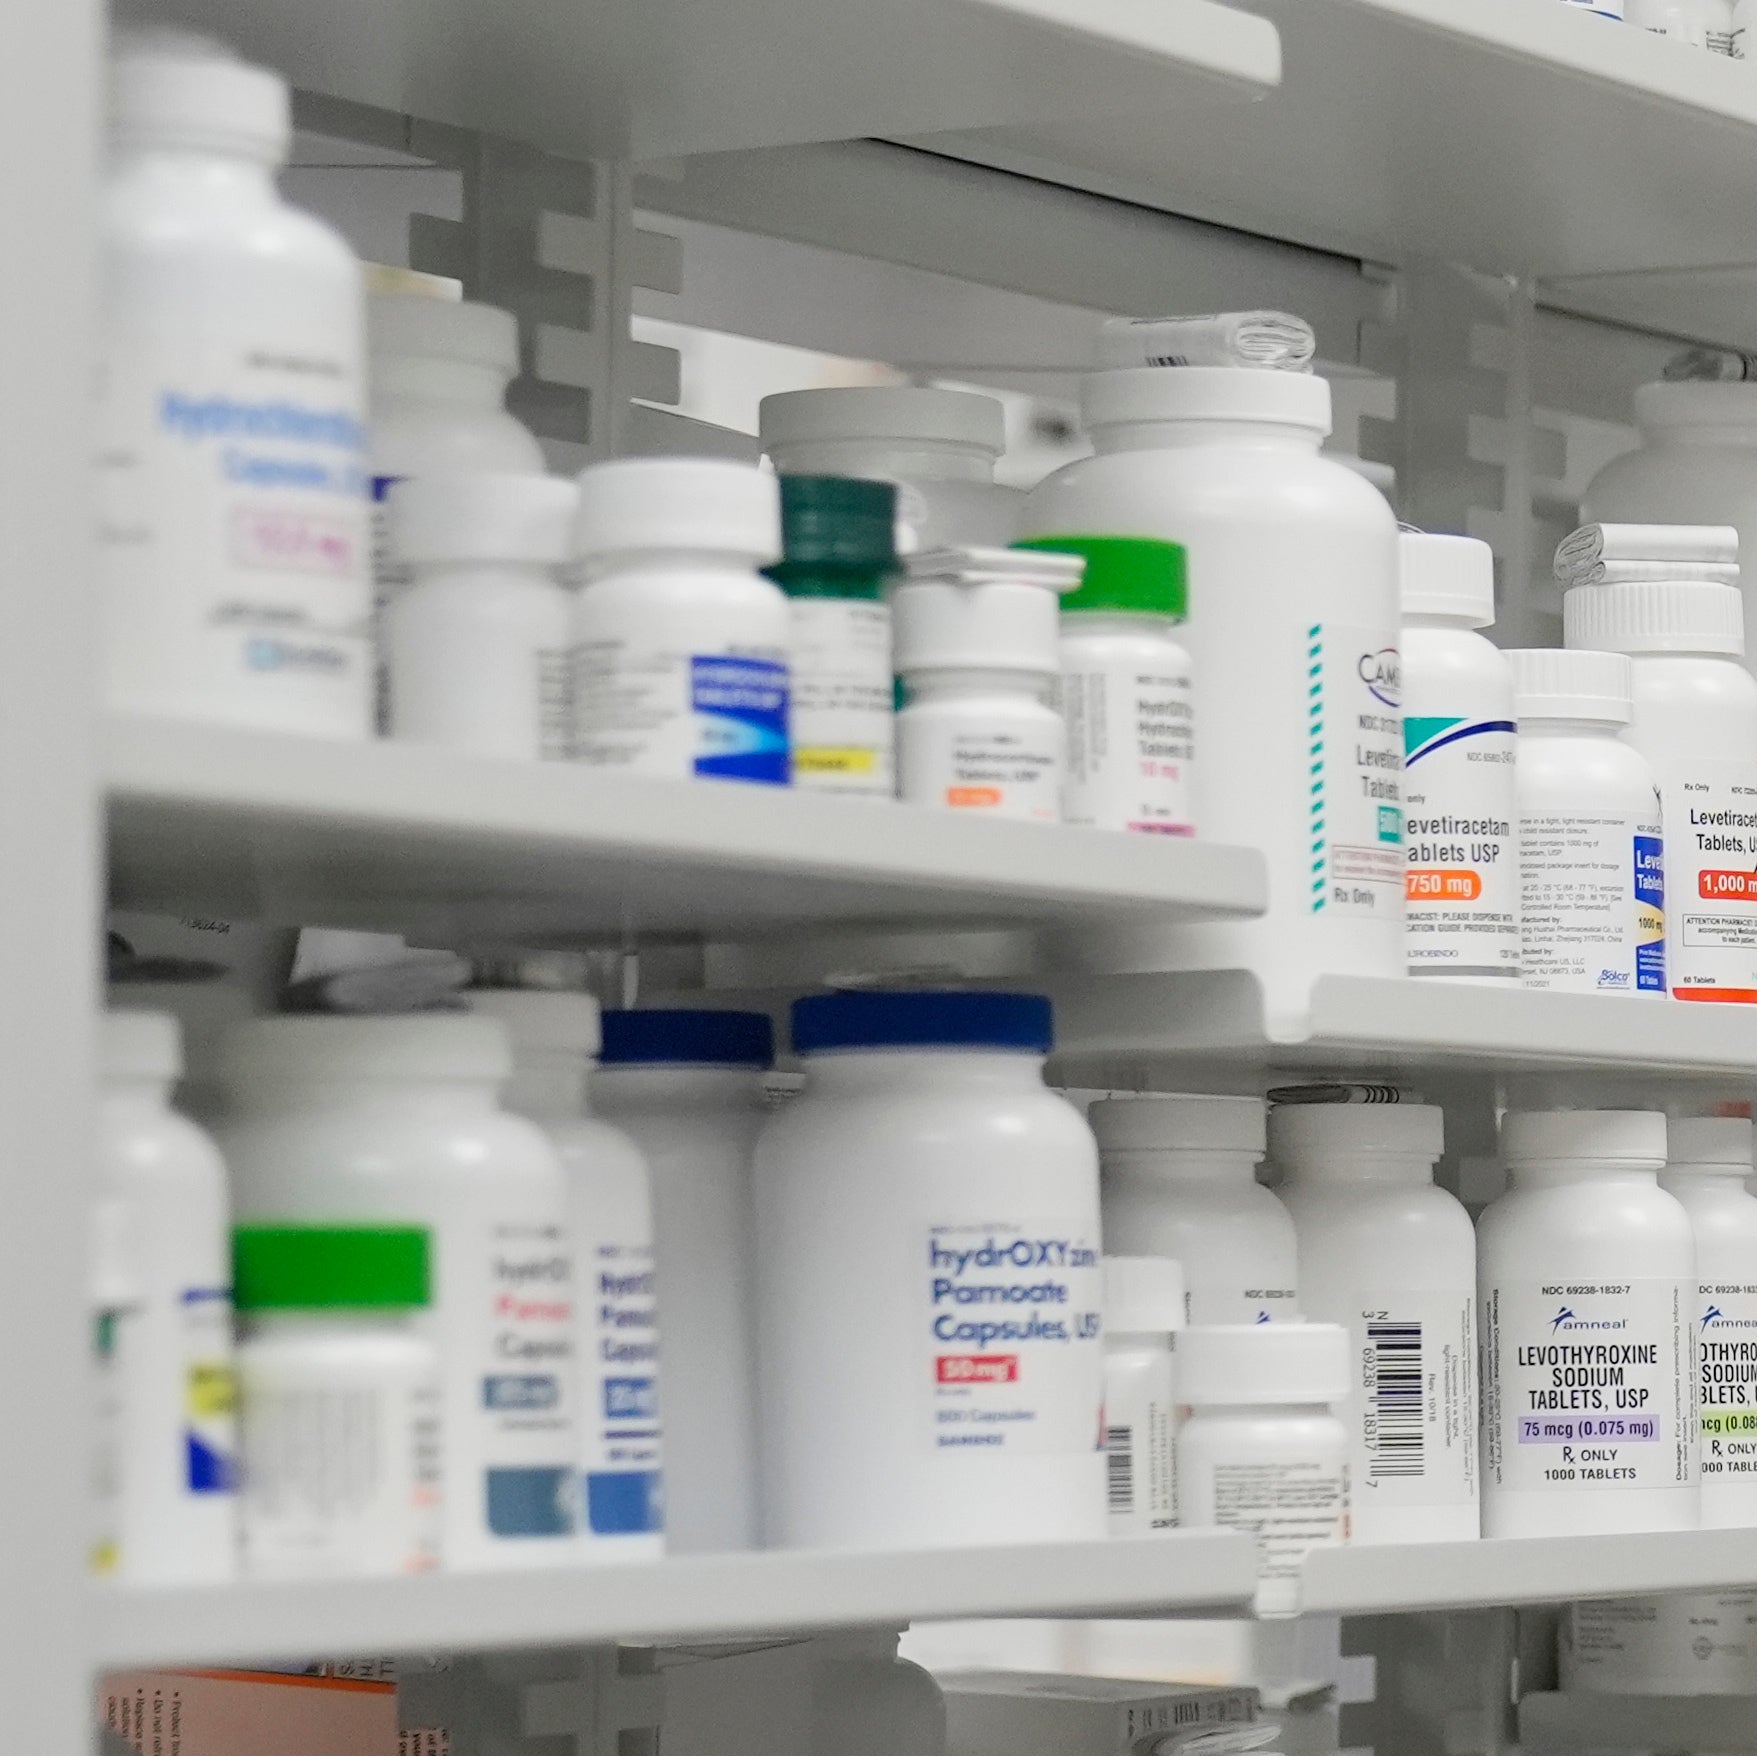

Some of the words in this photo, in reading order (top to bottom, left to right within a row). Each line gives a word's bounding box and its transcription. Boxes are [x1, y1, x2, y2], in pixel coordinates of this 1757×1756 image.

[1684, 783, 1695, 791] Rx
[1697, 783, 1710, 793] Only
[1408, 817, 1510, 837] evetiracetam
[1408, 844, 1465, 862] ablets
[1471, 844, 1500, 862] USP
[1696, 834, 1746, 855] Tablets,
[1408, 875, 1442, 893] 750
[1447, 876, 1472, 896] mg
[1703, 875, 1745, 893] 1,000
[1638, 917, 1654, 929] 1000
[1694, 976, 1716, 984] Tablets
[931, 1238, 1099, 1277] hydrOXYzin
[933, 1278, 1068, 1305] Pamoate
[1542, 1287, 1564, 1295] NDC
[1566, 1286, 1630, 1295] 69238-1832-7
[1362, 1311, 1374, 1319] 3
[1377, 1311, 1389, 1320] N
[934, 1311, 1071, 1350] Capsules,
[1564, 1319, 1626, 1330] amneal
[1519, 1344, 1658, 1366] LEVOTHYROXINE
[1362, 1348, 1376, 1388] 69238
[1552, 1367, 1624, 1387] SODIUM
[1529, 1389, 1609, 1412] TABLETS,
[1616, 1389, 1649, 1409] USP
[1364, 1413, 1377, 1451] 18317
[1524, 1422, 1540, 1436] 75
[1544, 1423, 1573, 1439] mcg
[1578, 1421, 1624, 1439] (0.075
[1629, 1422, 1653, 1436] mg)
[1581, 1449, 1618, 1461] ONLY
[1728, 1443, 1757, 1455] ONLY
[1544, 1469, 1575, 1480] 1000
[1580, 1468, 1636, 1480] TABLETS
[1365, 1480, 1378, 1488] 7
